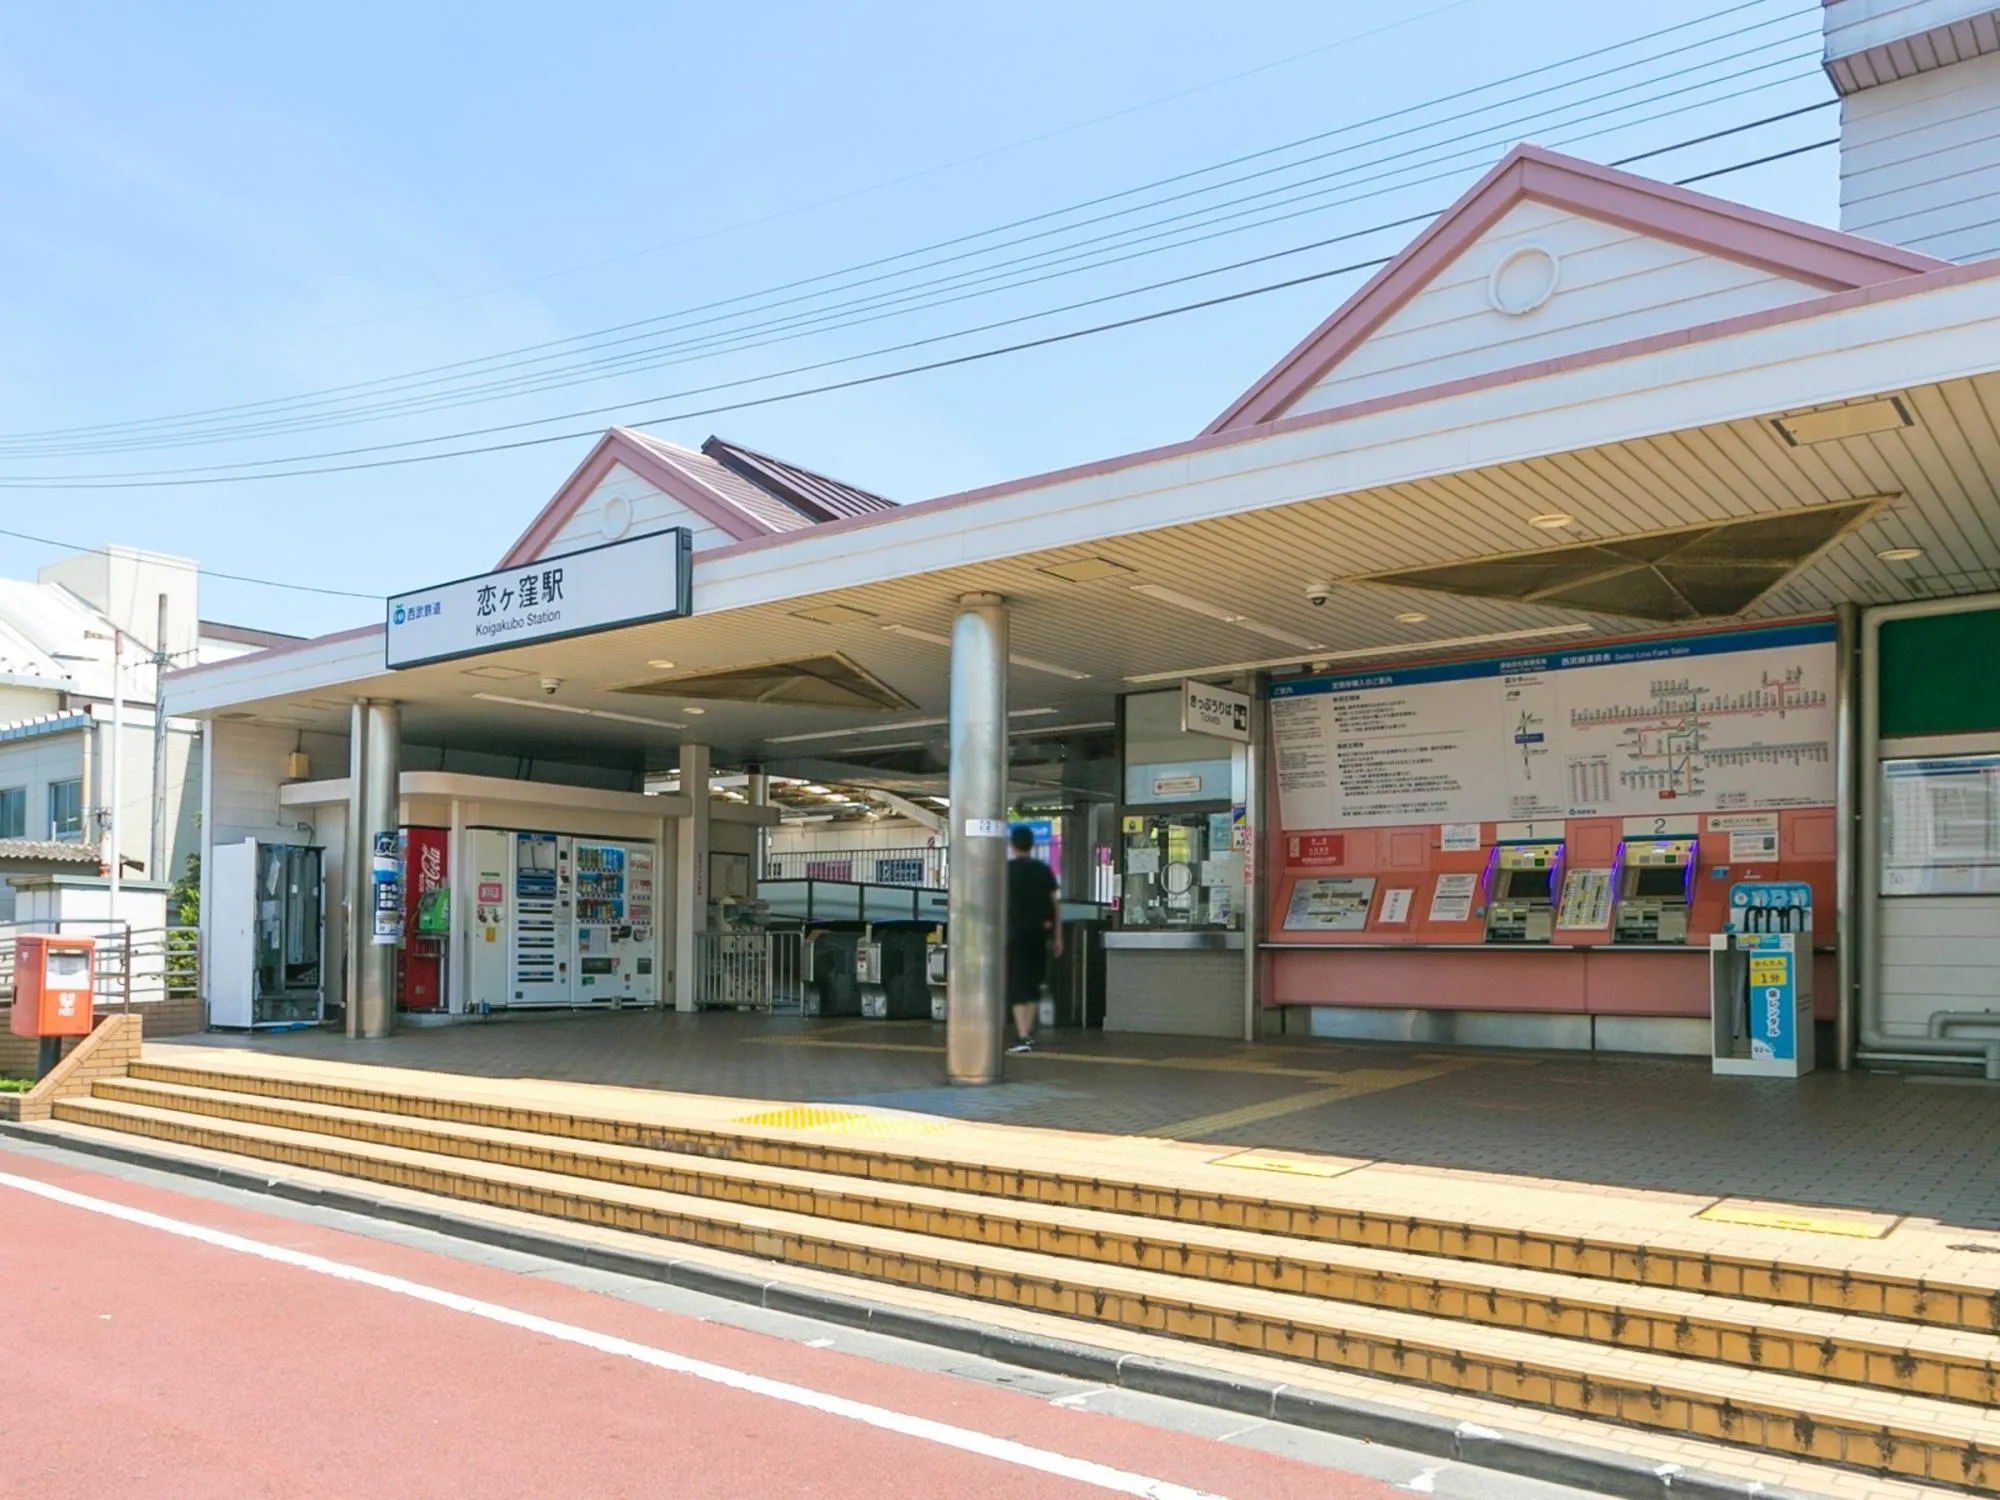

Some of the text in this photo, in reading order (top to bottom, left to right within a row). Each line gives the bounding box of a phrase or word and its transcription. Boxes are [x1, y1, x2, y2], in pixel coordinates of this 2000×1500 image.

[407, 601, 442, 621] 西武鉄道
[475, 609, 561, 637] Koigakubo Station
[1190, 694, 1233, 717] きっぷうりば
[1525, 823, 1533, 838] 1
[1654, 818, 1666, 834] 2
[1760, 973, 1780, 985] 1分
